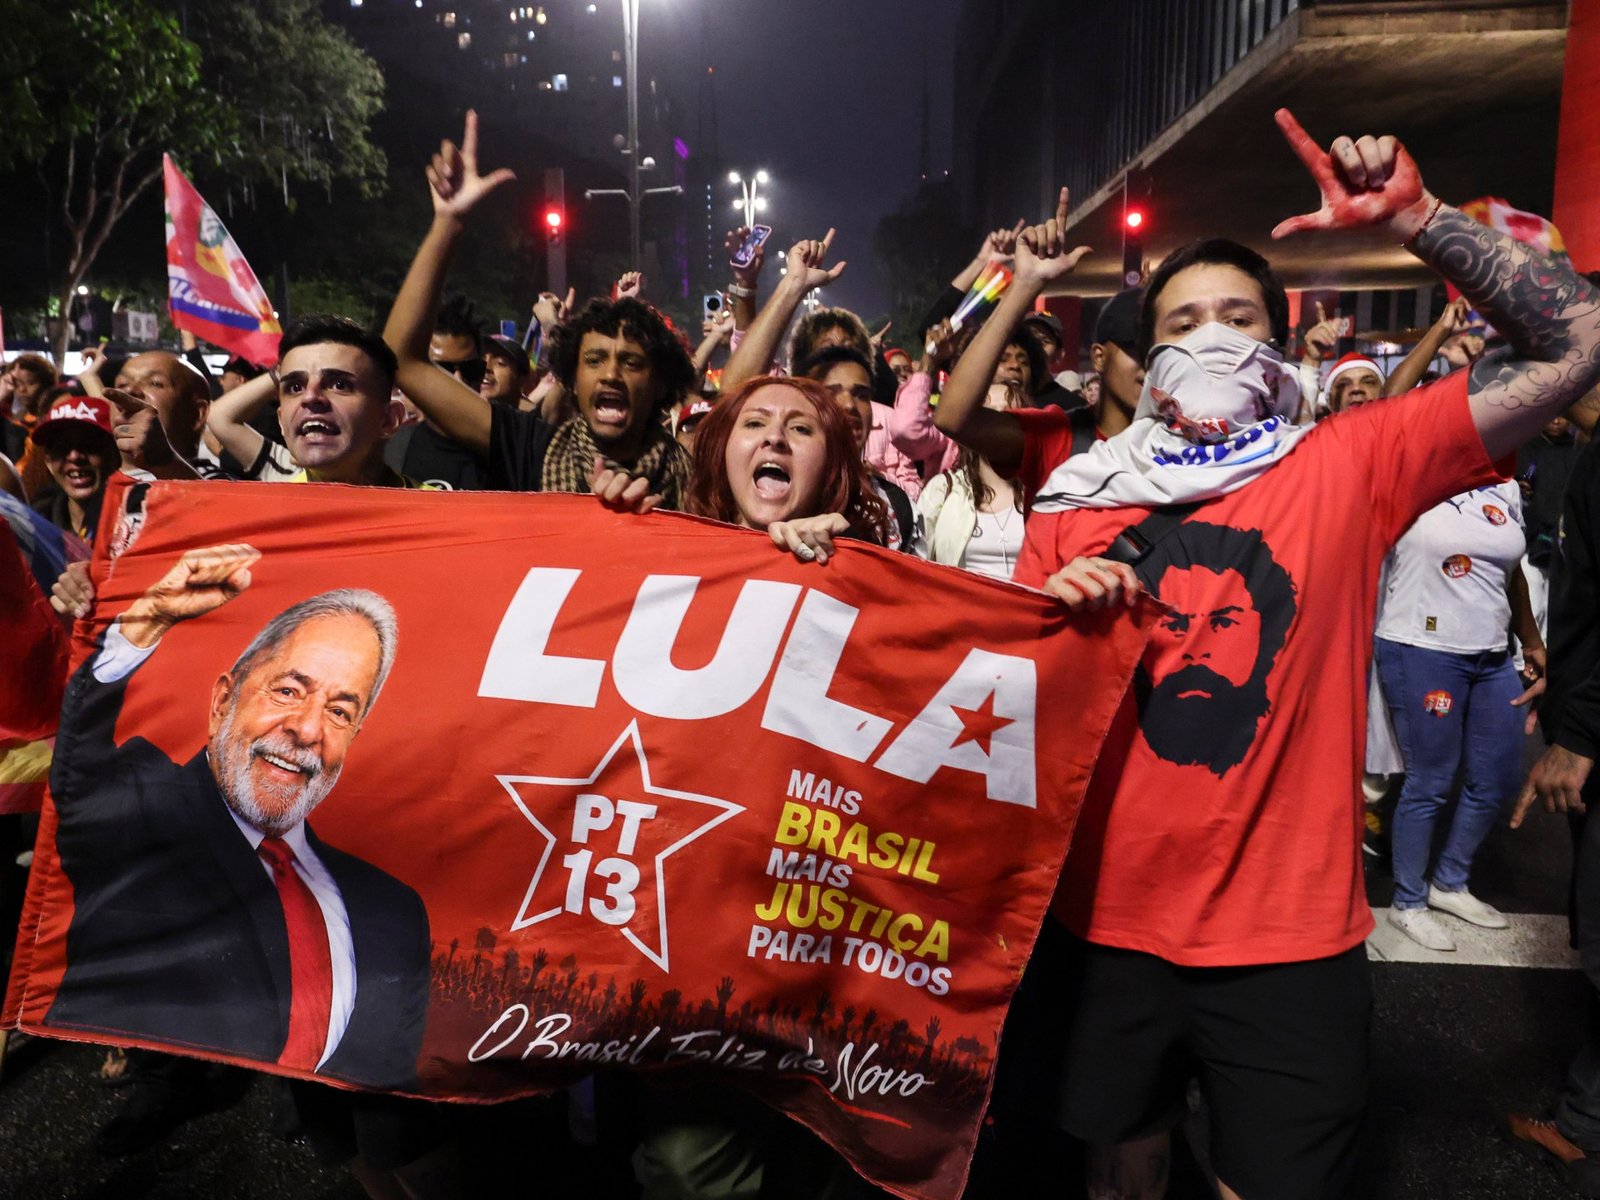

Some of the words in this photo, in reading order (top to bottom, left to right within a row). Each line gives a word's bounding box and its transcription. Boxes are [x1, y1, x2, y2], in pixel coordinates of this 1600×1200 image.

[477, 567, 1037, 809] LULA
[571, 794, 658, 856] PT
[786, 769, 863, 816] MAIS
[765, 847, 853, 889] MAIS
[774, 801, 940, 885] BRASIL
[563, 849, 640, 926] 13
[755, 882, 950, 963] JUSTIÇA
[747, 925, 833, 965] PARA
[842, 937, 953, 996] TODOS
[467, 1003, 530, 1063] O
[521, 1013, 661, 1065] Brasil
[777, 1037, 829, 1075] de
[829, 1042, 936, 1101] Novo
